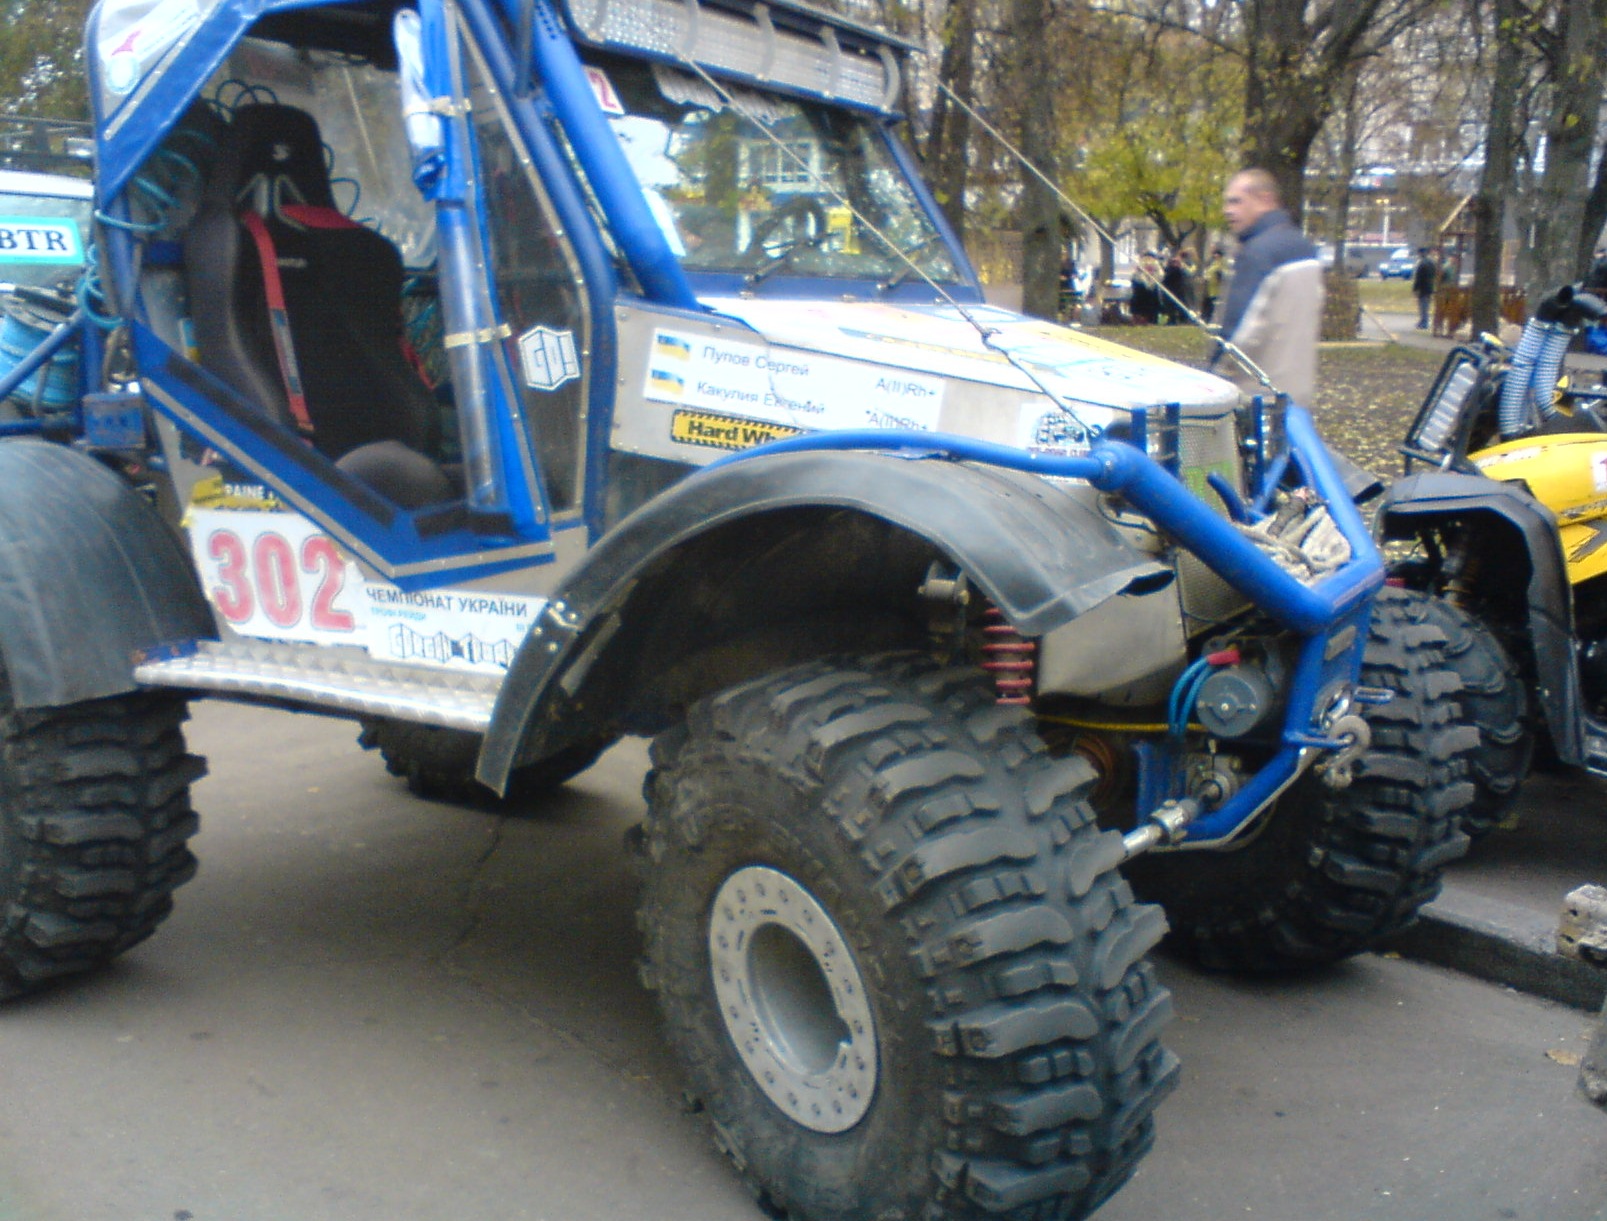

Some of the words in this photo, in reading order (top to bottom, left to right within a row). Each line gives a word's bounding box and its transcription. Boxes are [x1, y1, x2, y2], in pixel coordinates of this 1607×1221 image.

[0, 229, 68, 251] BTR
[755, 353, 809, 376] Сергей
[688, 419, 739, 442] Hard
[742, 426, 777, 445] Wh
[208, 529, 357, 633] 302
[458, 596, 529, 618] УКРАЇНИ
